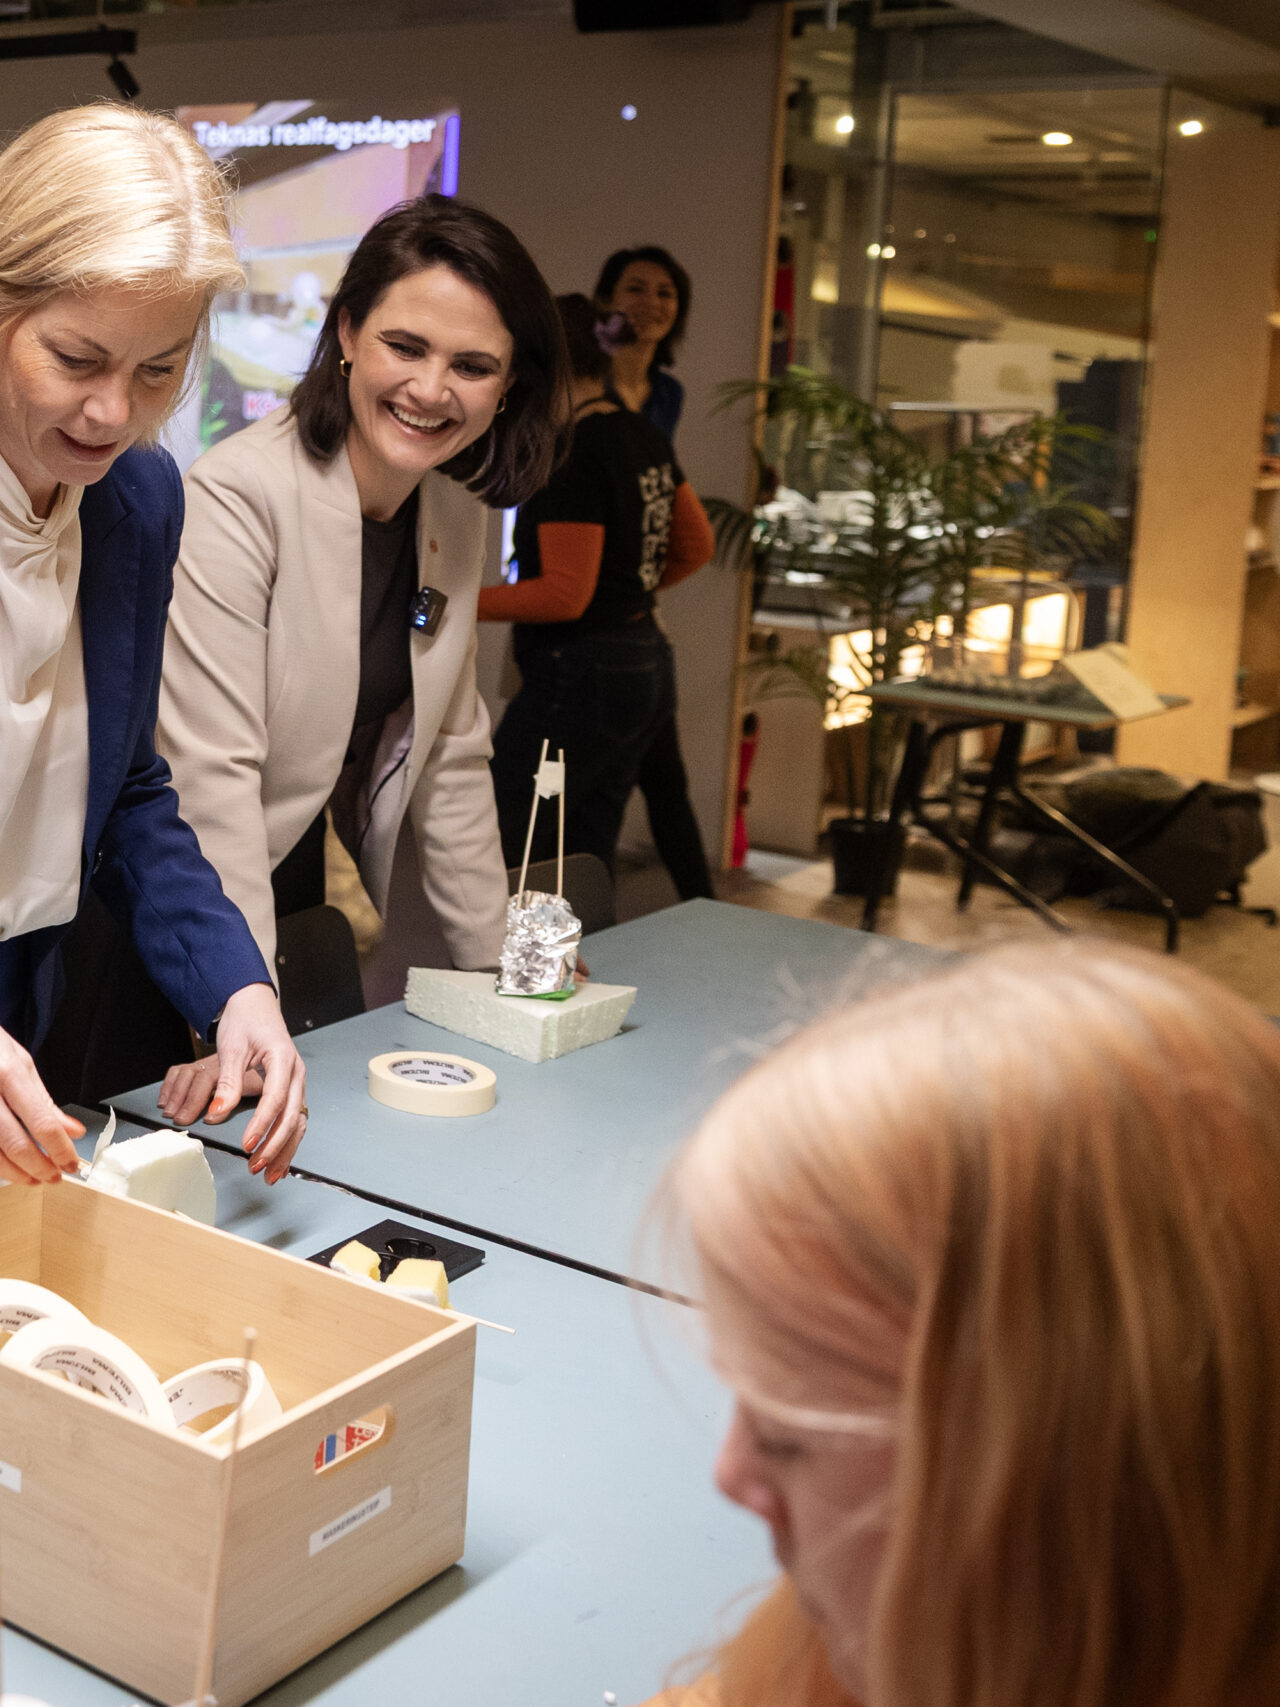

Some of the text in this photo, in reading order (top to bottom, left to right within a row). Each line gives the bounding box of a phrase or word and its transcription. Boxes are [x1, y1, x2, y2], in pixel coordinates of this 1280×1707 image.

[193, 115, 436, 150] Teknas realfagsdager
[423, 1060, 455, 1069] BILTEMA
[441, 1072, 468, 1084] BILTEMA
[92, 1357, 133, 1396] BILTEMA
